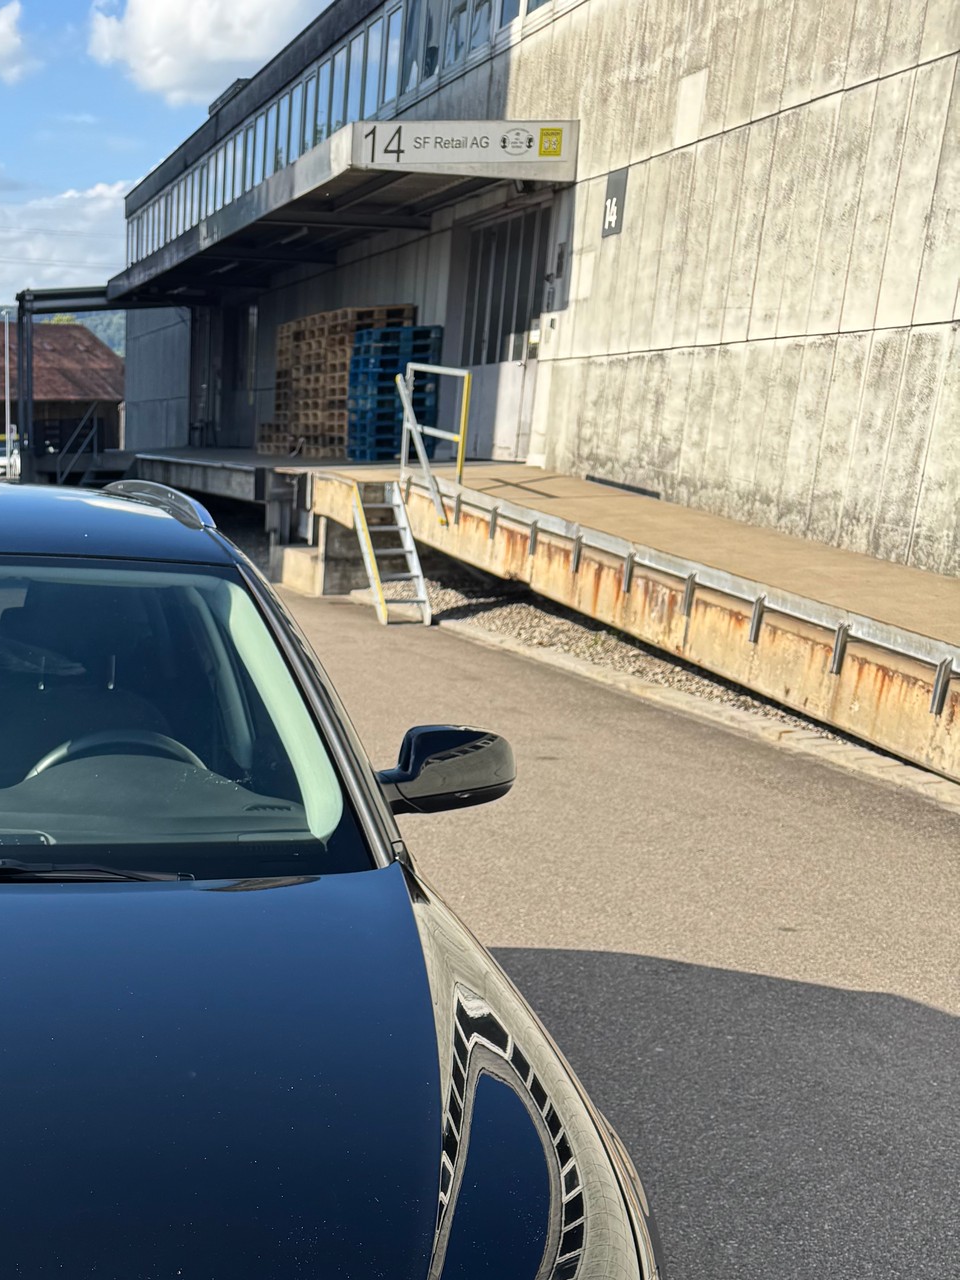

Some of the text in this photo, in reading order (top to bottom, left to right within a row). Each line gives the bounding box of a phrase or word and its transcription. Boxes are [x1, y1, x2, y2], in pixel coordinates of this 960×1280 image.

[364, 125, 490, 163] 14 SF Retail AG
[604, 197, 617, 230] 14
